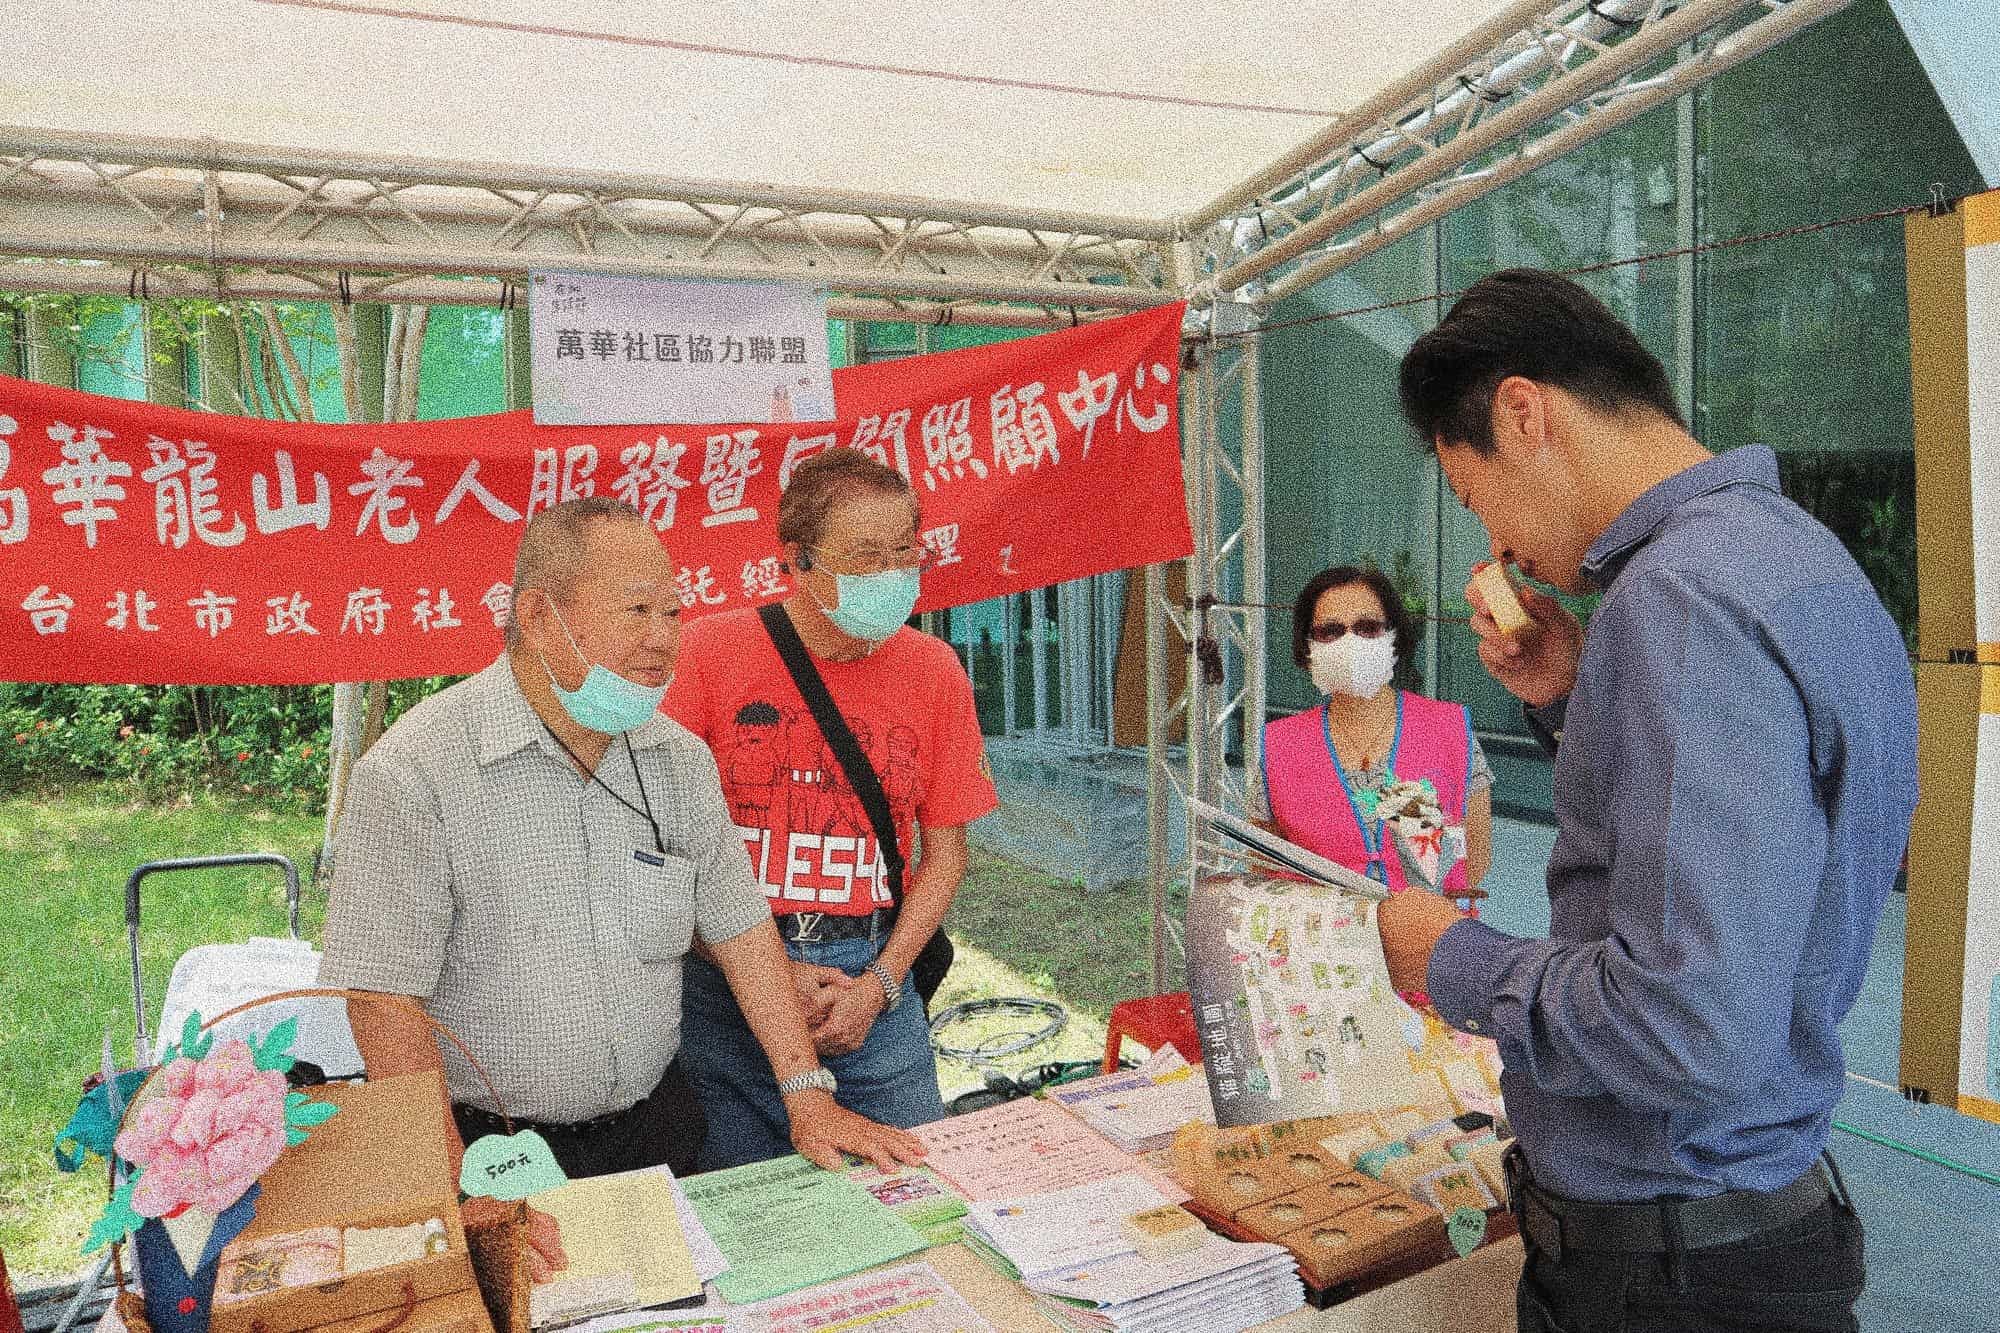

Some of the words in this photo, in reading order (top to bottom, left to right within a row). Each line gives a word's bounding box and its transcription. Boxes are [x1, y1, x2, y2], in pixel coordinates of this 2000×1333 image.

[556, 329, 808, 364] 萬華社區協力聯盟
[484, 1152, 533, 1181] 500元
